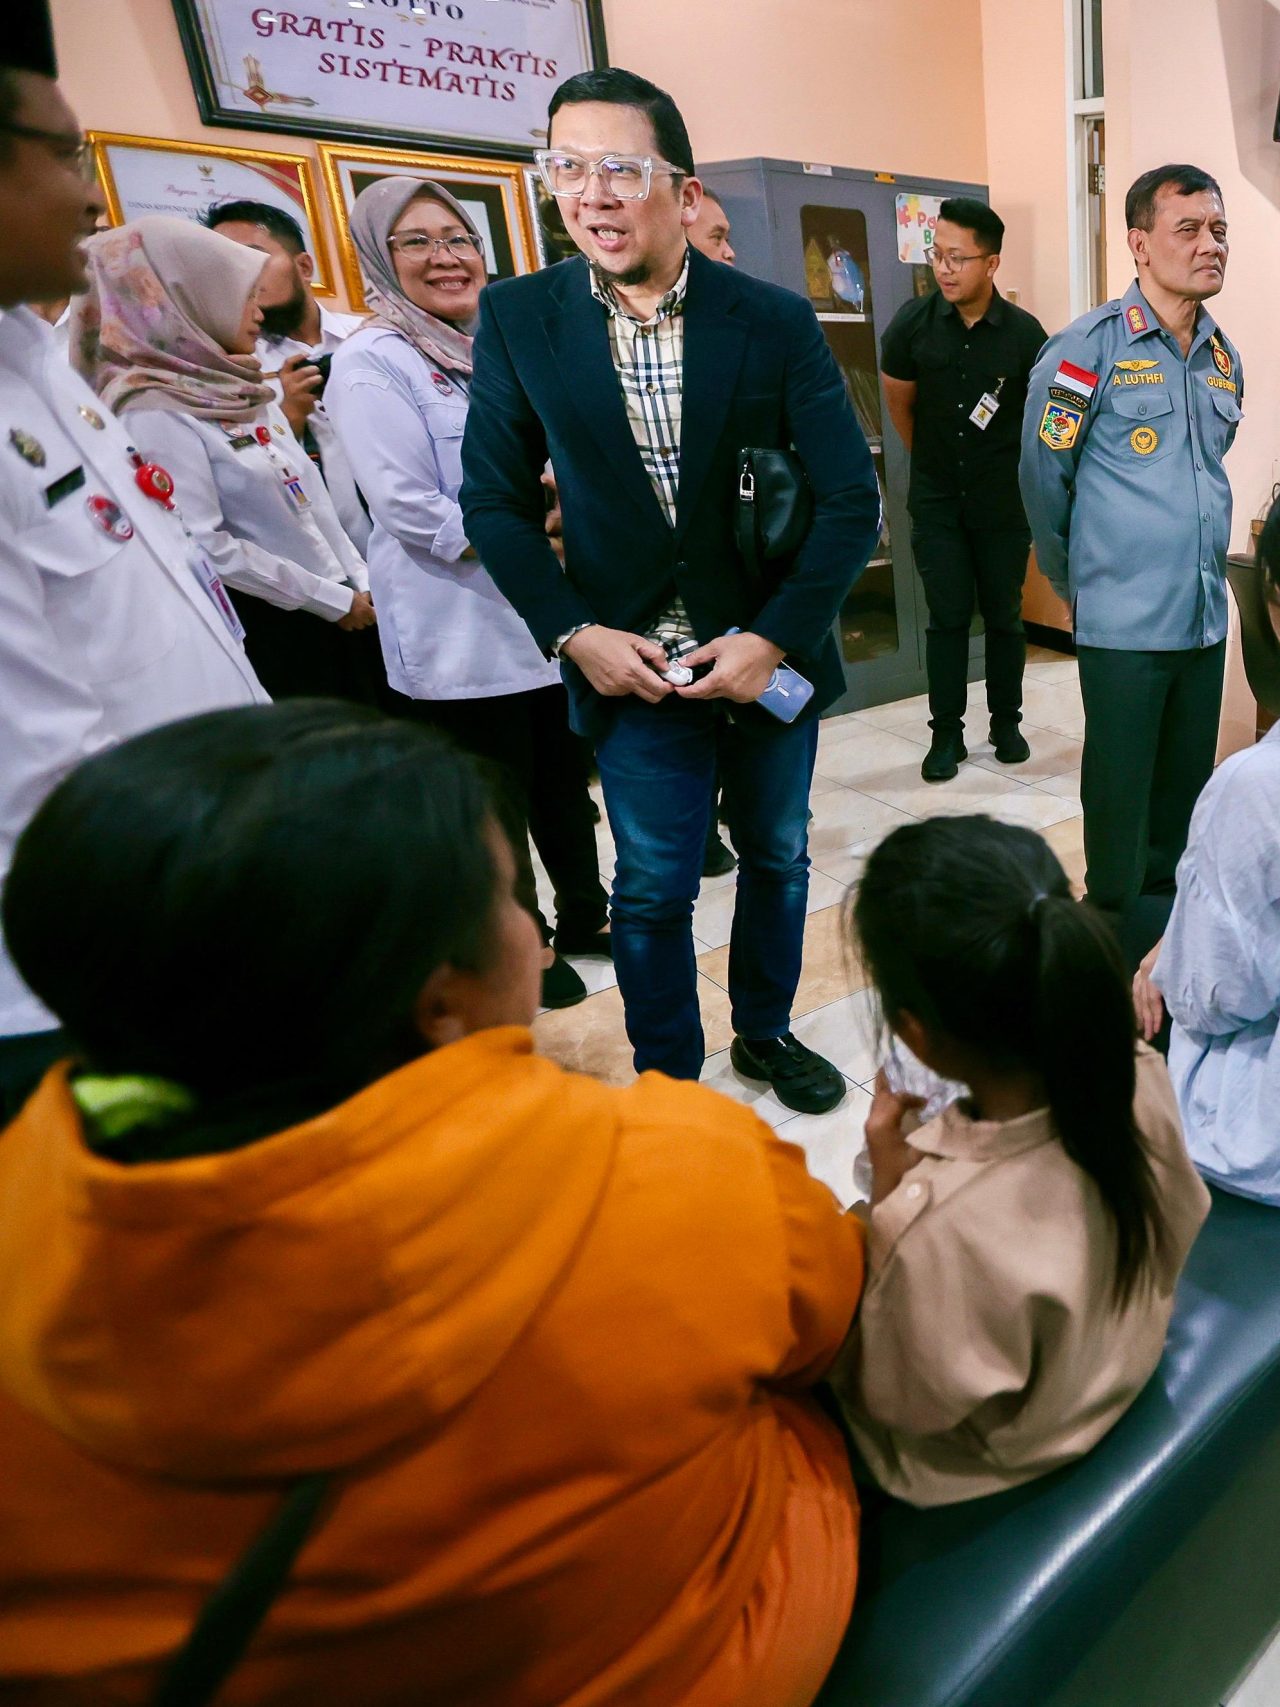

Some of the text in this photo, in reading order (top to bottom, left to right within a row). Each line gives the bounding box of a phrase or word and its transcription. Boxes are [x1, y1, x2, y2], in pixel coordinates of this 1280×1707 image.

[367, 0, 463, 19] TTO
[251, 8, 385, 49] GRATIS
[424, 37, 558, 79] PRAKTIS
[317, 52, 516, 102] SISTEMATIS
[1113, 372, 1164, 386] A LUTHFI
